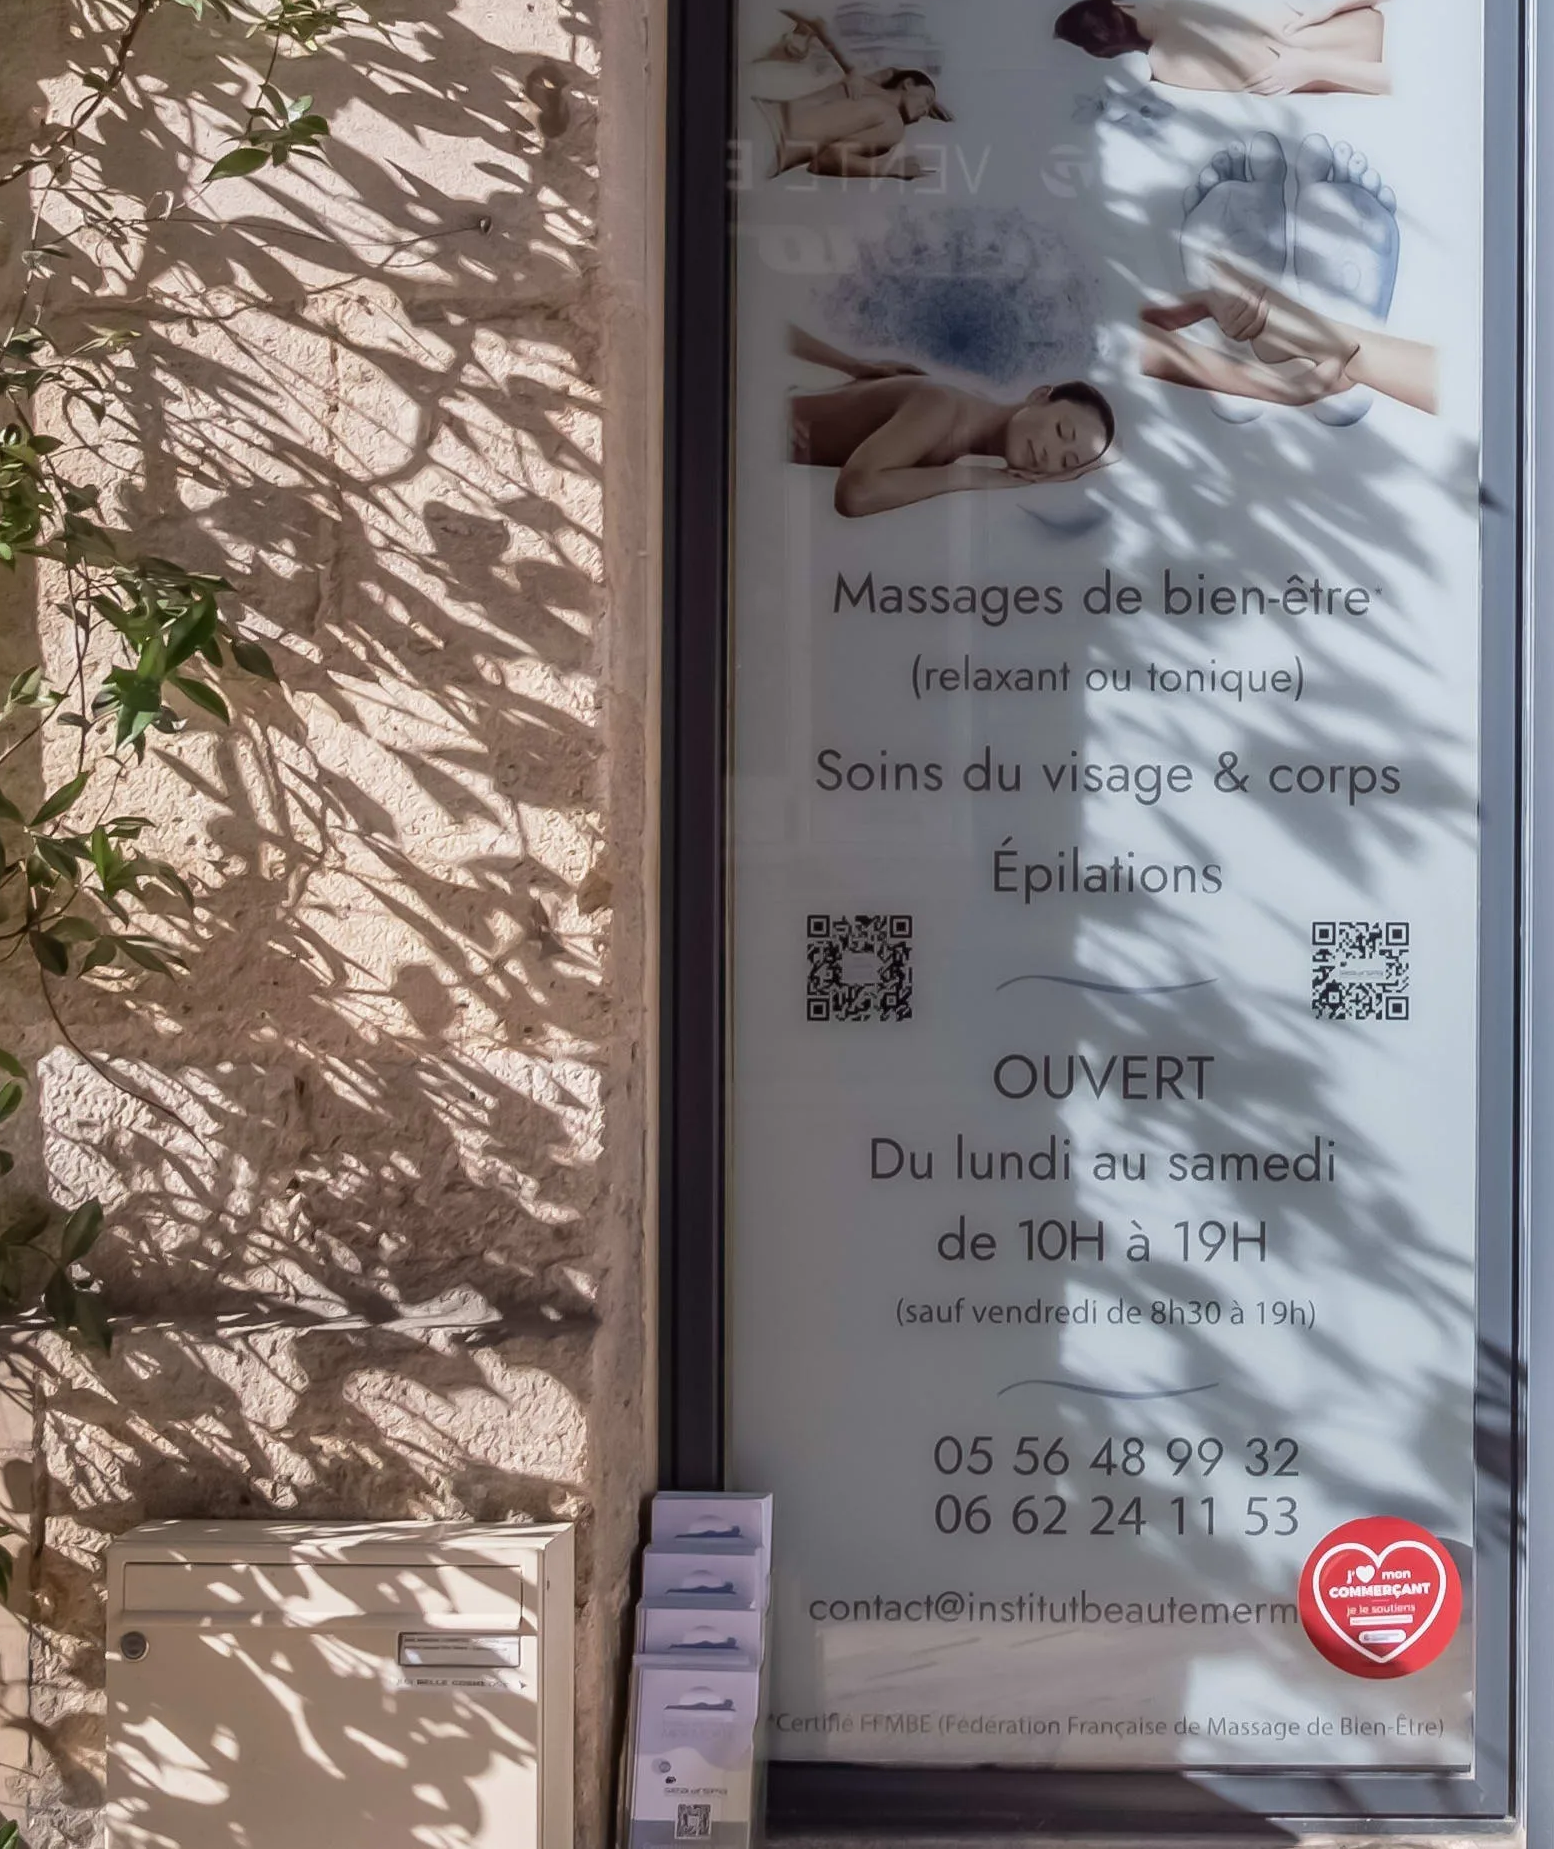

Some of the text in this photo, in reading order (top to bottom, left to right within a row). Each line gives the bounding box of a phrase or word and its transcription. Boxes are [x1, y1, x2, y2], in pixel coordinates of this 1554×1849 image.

[832, 570, 1064, 627] Massages
[1082, 568, 1143, 616] de
[912, 654, 1306, 703] (relaxant ou tonique)
[815, 746, 1402, 806] Soins du visage & corps
[992, 837, 1225, 905] Épilations
[993, 1053, 1216, 1101] OUVERT
[870, 1135, 1338, 1184] Du lundi au samedi
[937, 1216, 1269, 1263] de 10H à 19H
[896, 1296, 1318, 1331] (sauf vendredi de 8h30 à 19h)
[934, 1435, 1301, 1478] 05 56 48 99 32
[934, 1494, 1301, 1537] 06 62 24 11 53
[1328, 1582, 1431, 1599] COMMERÇANT
[1381, 1569, 1412, 1581] mon
[1371, 1603, 1416, 1615] soutiens
[938, 1712, 1061, 1738] (Fédération
[1067, 1714, 1167, 1740] Française
[1174, 1714, 1200, 1737] de
[1207, 1715, 1301, 1741] Massage
[1307, 1715, 1334, 1737] de
[1341, 1712, 1445, 1740] Bien-Être)
